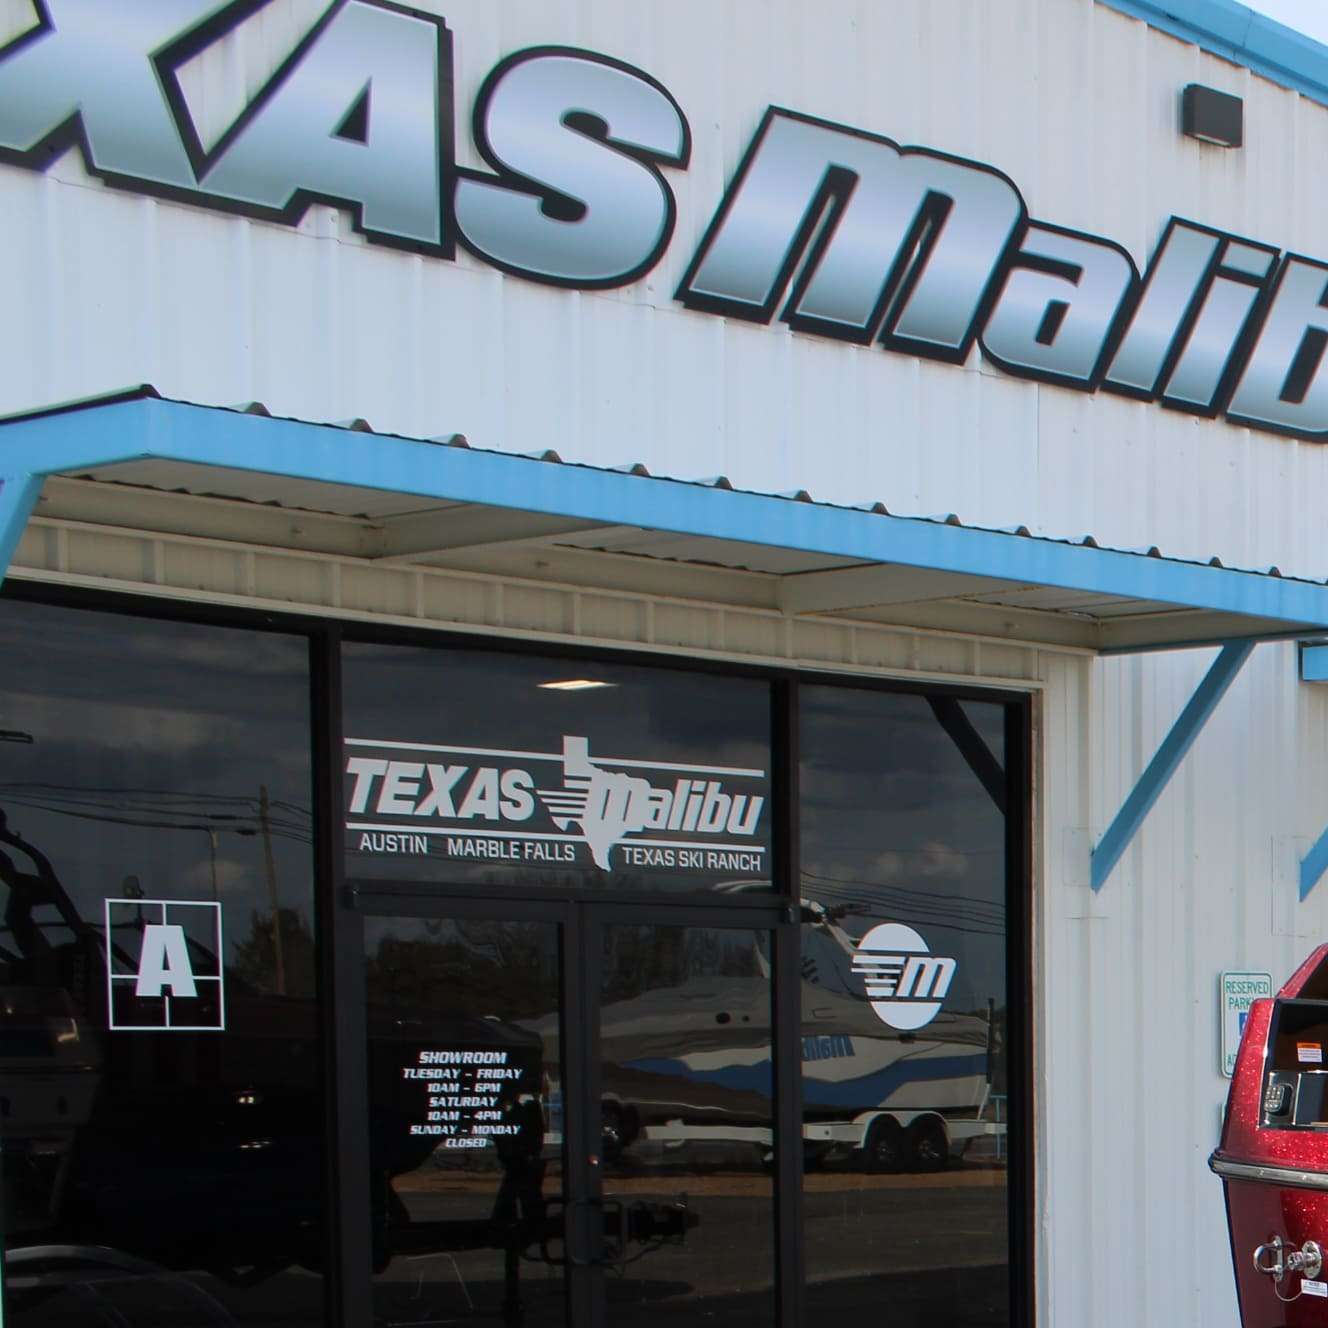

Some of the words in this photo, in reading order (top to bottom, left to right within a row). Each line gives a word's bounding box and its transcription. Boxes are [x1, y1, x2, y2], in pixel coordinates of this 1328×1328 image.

[345, 757, 536, 822] TEXAS
[359, 832, 428, 855] AUSTIN
[447, 837, 521, 861] MARBLE
[524, 842, 576, 862] FALLS
[622, 846, 675, 868] TEXAS
[678, 850, 704, 869] SKI
[706, 851, 762, 872] RANCH
[1225, 981, 1269, 995] RESERVED
[418, 1051, 508, 1064] SHOWROOM
[403, 1068, 461, 1079] TUESDAY
[476, 1068, 524, 1079] FRIDAY
[427, 1083, 459, 1093] 10AM
[474, 1083, 502, 1093] 6PM
[428, 1097, 498, 1107] SATURDAY
[427, 1111, 459, 1121] 10AM
[474, 1111, 502, 1121] 4PM
[410, 1125, 458, 1135] SUNDAY
[471, 1125, 521, 1135] MONDAY
[445, 1138, 487, 1148] CLOSED
